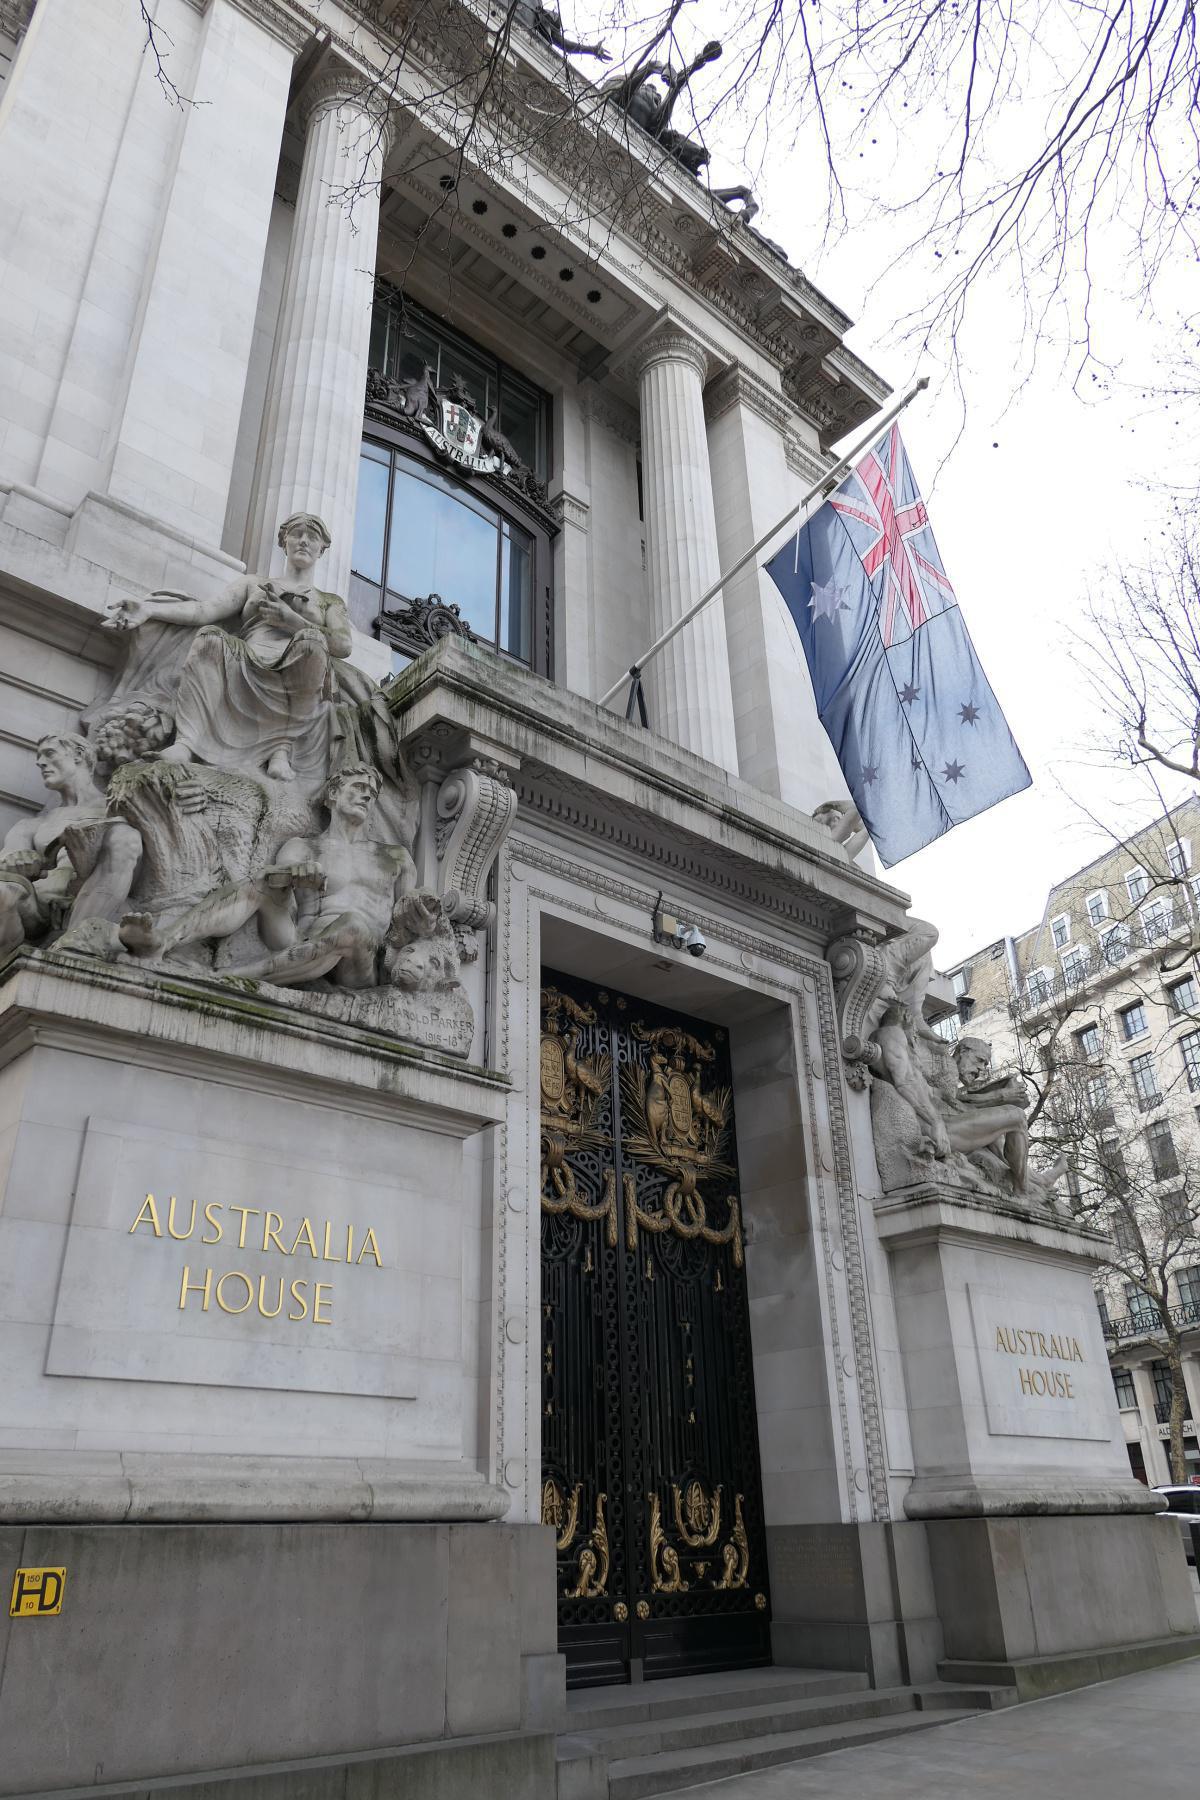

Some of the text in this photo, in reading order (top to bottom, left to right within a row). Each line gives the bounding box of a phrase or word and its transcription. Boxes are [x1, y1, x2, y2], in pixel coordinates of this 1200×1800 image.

[427, 428, 489, 471] AUSTRALIA
[386, 1000, 474, 1034] HAROLD PARKER
[425, 1031, 458, 1047] 1915-18
[128, 1193, 383, 1268] AUSTRALIA
[178, 1265, 333, 1325] HOUSE
[996, 1326, 1083, 1363] AUSTRALIA
[1018, 1367, 1075, 1399] HOUSE
[15, 1572, 62, 1613] HD
[27, 1575, 40, 1583] 150
